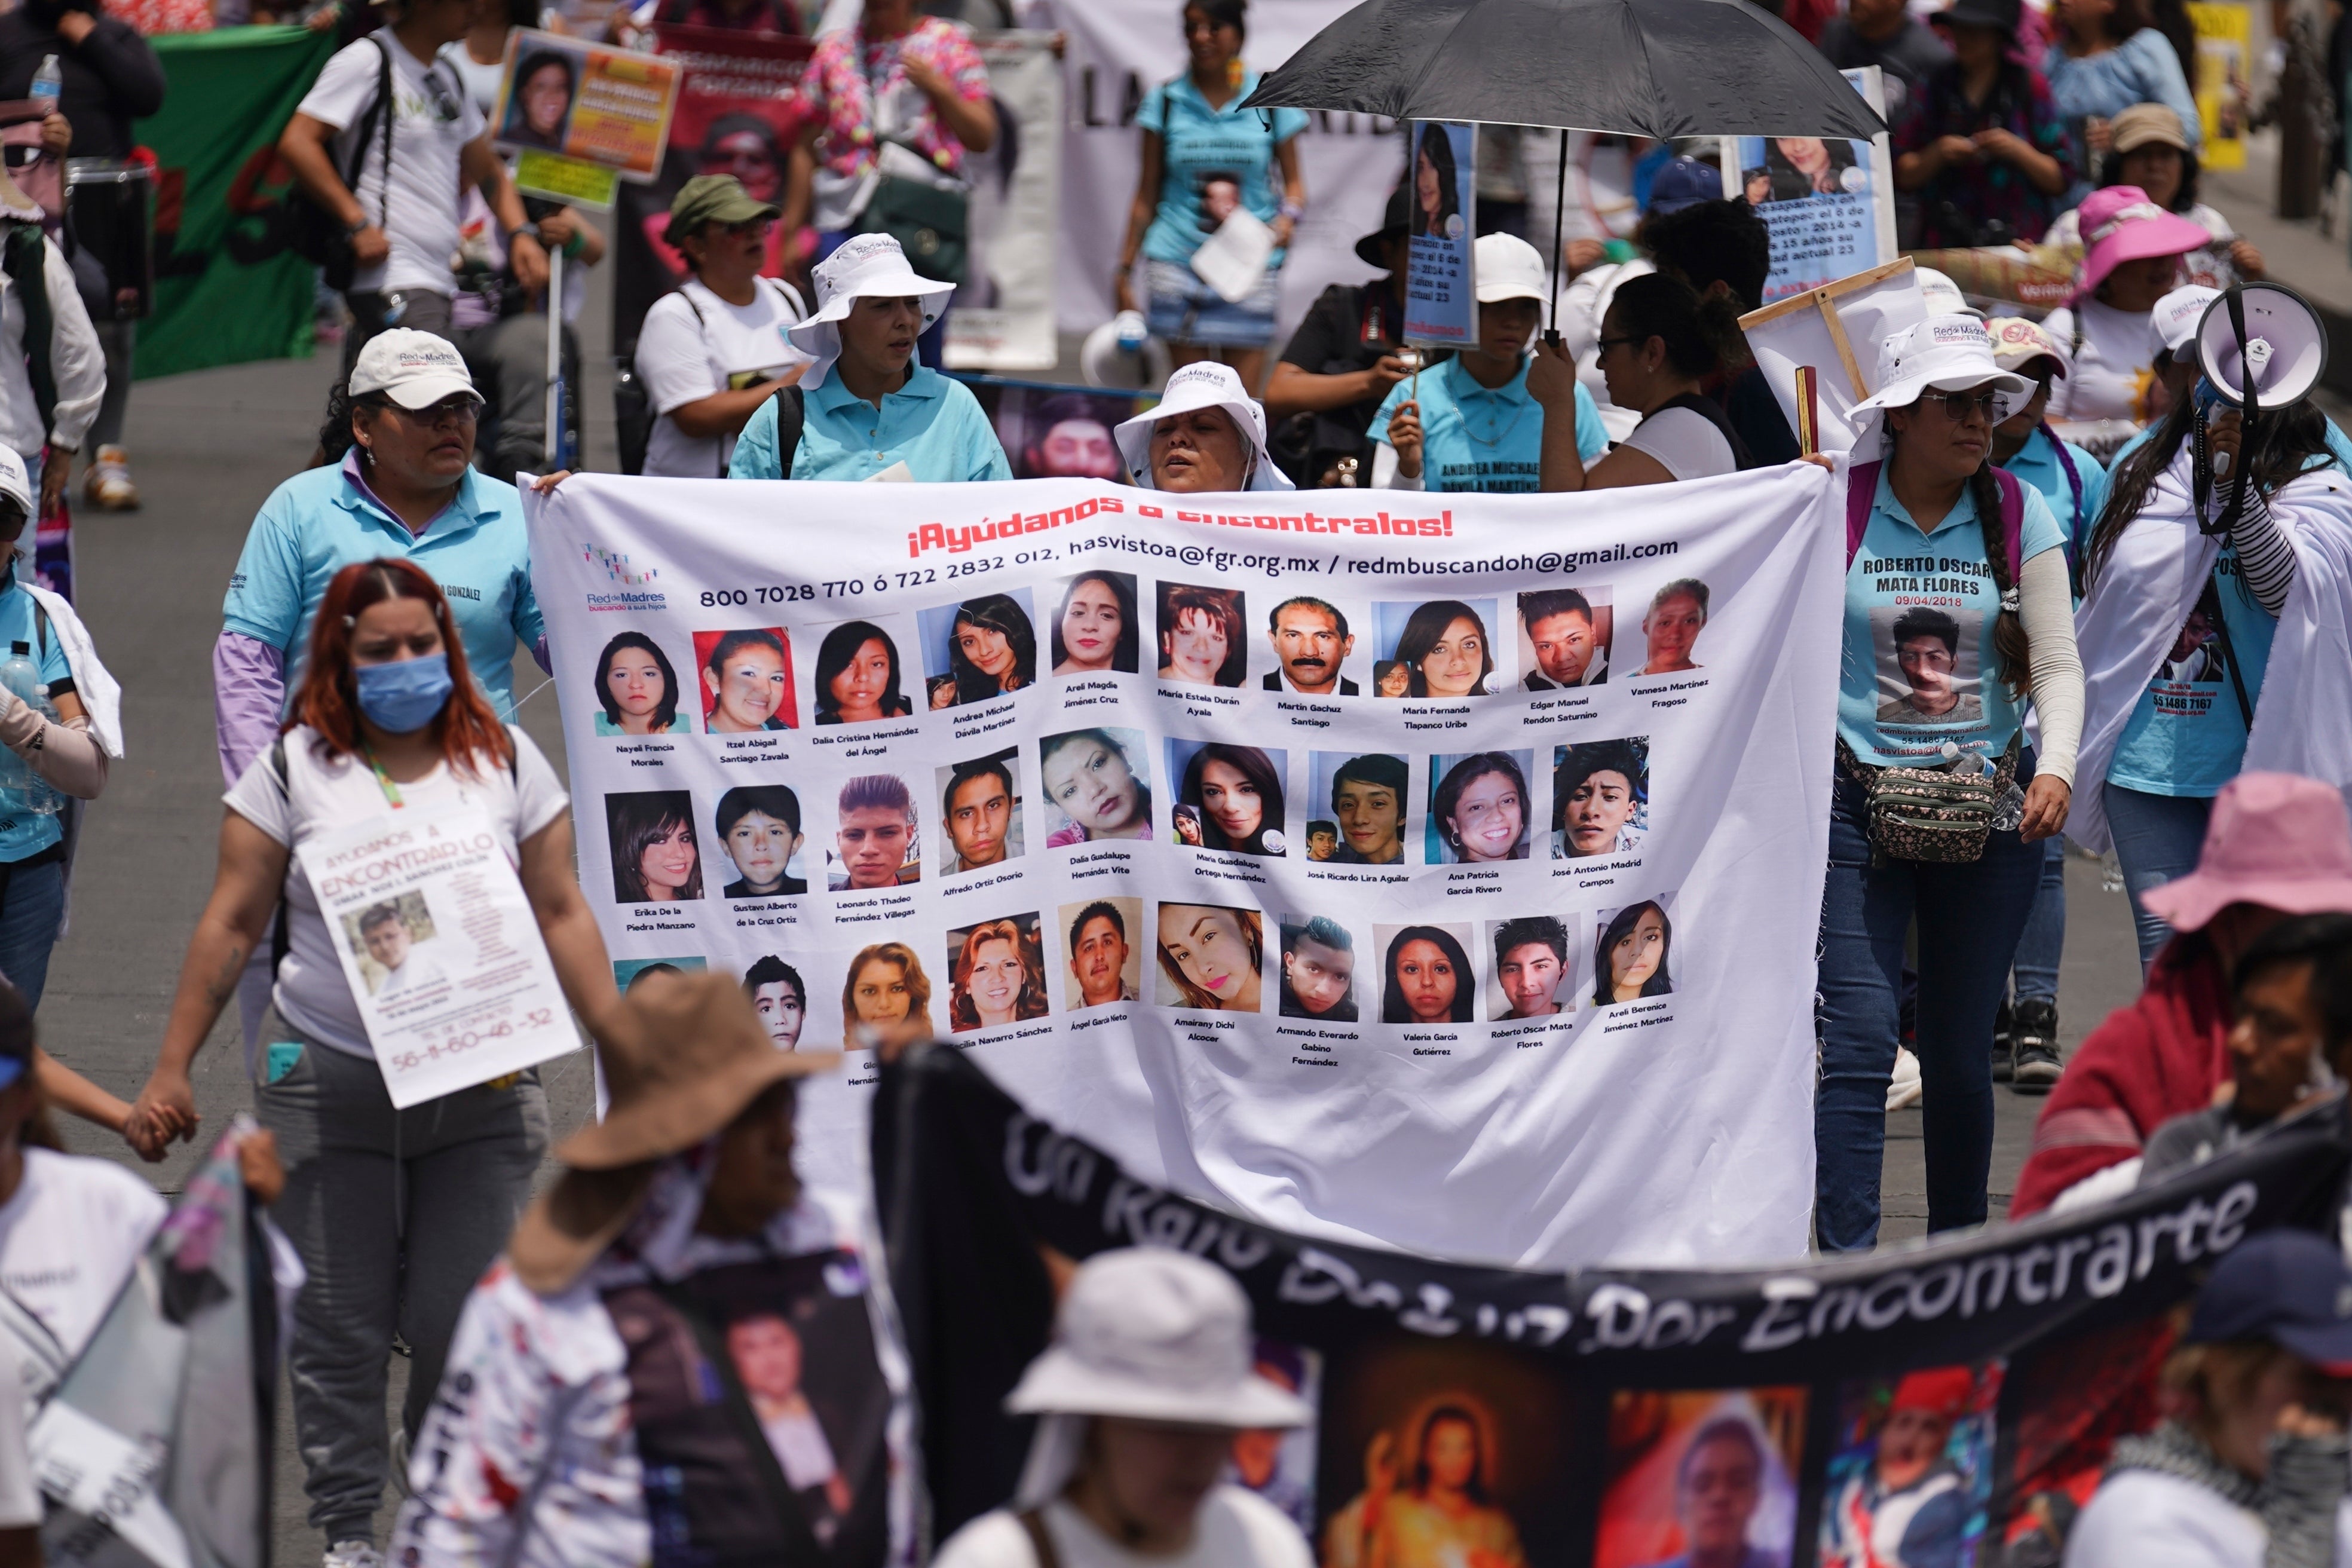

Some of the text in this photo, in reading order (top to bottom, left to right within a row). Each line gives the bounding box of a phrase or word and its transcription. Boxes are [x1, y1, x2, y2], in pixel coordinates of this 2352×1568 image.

[1933, 326, 1987, 338] Red Madres
[1188, 369, 1226, 382] Madres
[908, 497, 1124, 558] ¡Ayúdanos
[700, 589, 748, 607] 800
[755, 584, 816, 604] 7028
[822, 579, 864, 598] 770
[873, 574, 888, 591] ó
[895, 568, 936, 589] 722
[947, 556, 1005, 580] 2832
[1070, 534, 1321, 577] hasvistoa@fgr.org.mx
[1328, 555, 1340, 574] /
[1348, 540, 1679, 574] redmbuscandoh@gmail.com
[1863, 556, 1991, 579] ROBERTO OSCAR
[1876, 577, 1980, 595] MATA FLORES
[448, 584, 480, 601] GONZÁLEZ
[587, 593, 611, 604] Red
[621, 592, 665, 603] Madres
[589, 603, 627, 612] buscando
[648, 602, 666, 611] hijos
[1895, 595, 1962, 607] 09/04/2018
[1065, 683, 1086, 693] Areli
[1631, 678, 1709, 697] Vannesa Martínez
[1064, 696, 1097, 709] Jiménez
[1157, 688, 1240, 706] María Estela Durán
[1652, 697, 1687, 709] Fragoso
[2153, 694, 2212, 709] 55 1486 7167
[1310, 704, 1342, 713] Gachuz
[1430, 705, 1470, 714] Fernanda
[1530, 697, 1589, 711] Edgar Manuel
[953, 701, 1015, 725] Andrea Michael
[1187, 707, 1212, 716] Ayala
[1523, 710, 1598, 725] Rendon Saturnino
[955, 715, 1016, 739] Dávila Martínez
[1291, 717, 1330, 728] Santiago
[1404, 720, 1468, 731] Tlapanco Uribe
[812, 727, 920, 745] Dalia Cristina Hernández
[1917, 736, 1940, 744] 1486
[616, 743, 675, 754] Nayeli Francia
[726, 738, 777, 749] Itzel Abigail
[845, 745, 887, 758] del Ángel
[631, 758, 664, 767] Morales
[719, 752, 789, 764] Santiago Zavala
[326, 830, 414, 869] AYUDANOS
[1070, 852, 1131, 865] Dalia Guadalupe
[1218, 857, 1261, 869] Guadalupe
[1071, 866, 1130, 880] Hernández Vite
[1551, 858, 1642, 878] José Antonio Madrid
[1195, 868, 1266, 884] Ortega Hernández
[1307, 871, 1410, 884] José Ricardo Lira Aguilar
[1448, 870, 1499, 881] Ana Patricia
[942, 871, 1023, 897] Alfredo Ortiz Osorio
[1475, 885, 1502, 894] Rivero
[1579, 878, 1615, 889] Campos
[733, 902, 798, 912] Gustavo Alberto
[836, 896, 912, 909] Leonardo Thadeo
[634, 908, 657, 917] Erika
[673, 907, 681, 915] la
[835, 908, 915, 923] Fernández Villegas
[626, 921, 696, 932] Piedra Manzano
[736, 915, 797, 927] de la Cruz Ortiz
[1608, 1002, 1667, 1019] Areli Berenice
[1070, 1019, 1091, 1031] Ángel
[1174, 1018, 1235, 1030] Amairany Dichi
[1603, 1015, 1674, 1034] Jiménez Martínez
[978, 1025, 1053, 1046] Navarro Sánchez
[1276, 1026, 1359, 1040] Armando Everardo
[1491, 1022, 1573, 1039] Roberto Oscar Mata
[1188, 1033, 1219, 1043] Alcocer
[1301, 1043, 1331, 1053] Gabino
[1517, 1040, 1544, 1049] Flores
[1413, 1046, 1451, 1056] Gutiérrez
[1292, 1056, 1339, 1067] Fernández
[1741, 1180, 2258, 1354] Encontrarte
